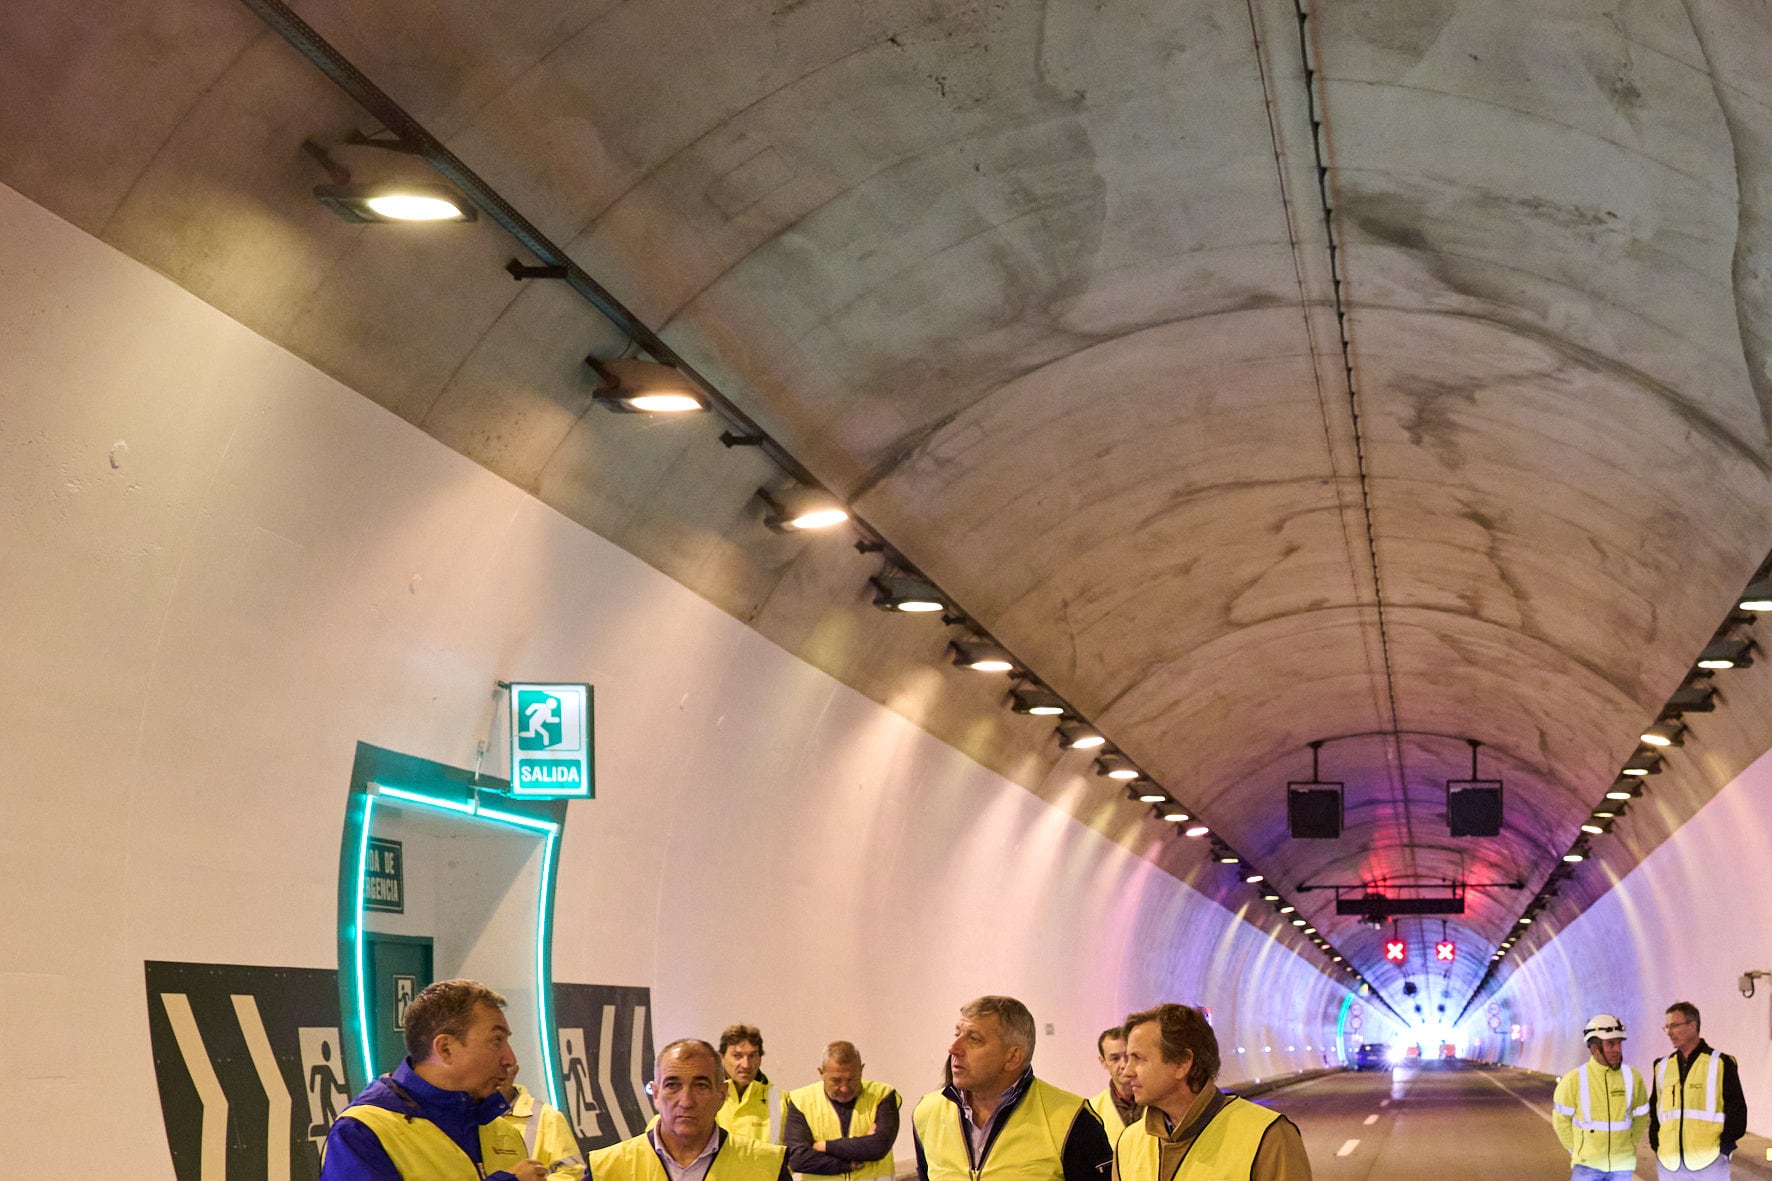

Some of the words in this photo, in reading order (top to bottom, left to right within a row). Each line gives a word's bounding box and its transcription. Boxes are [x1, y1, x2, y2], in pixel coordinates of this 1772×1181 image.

[521, 766, 579, 782] SALIDA
[384, 851, 395, 874] DE
[365, 876, 399, 902] RGENCIA
